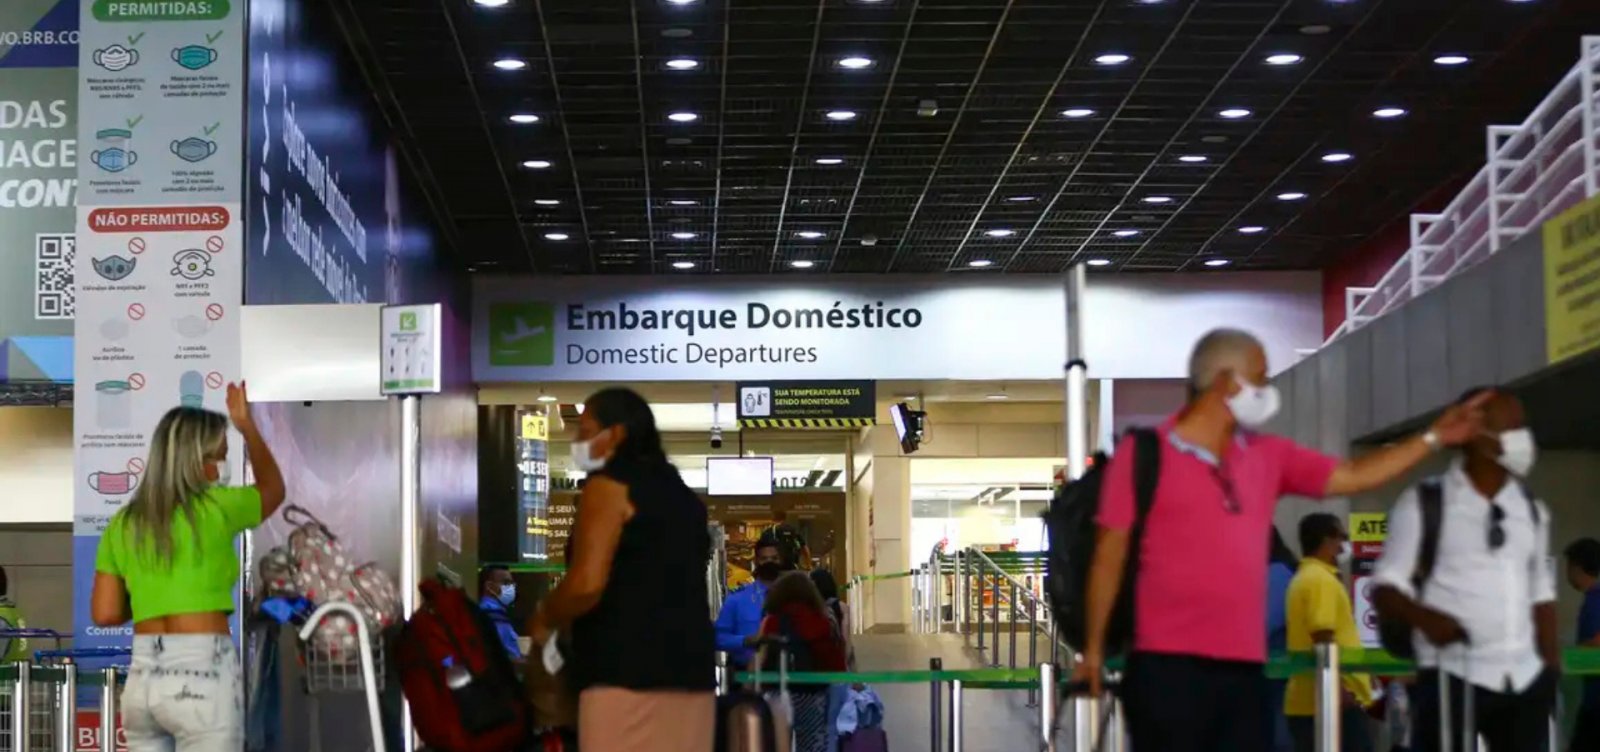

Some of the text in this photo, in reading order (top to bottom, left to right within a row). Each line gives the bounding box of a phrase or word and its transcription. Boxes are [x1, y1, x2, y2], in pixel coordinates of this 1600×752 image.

[108, 1, 212, 16] PERMITIDAS:
[0, 99, 68, 129] DAS
[95, 211, 224, 227] NÃO PERMITIDAS:
[566, 301, 923, 336] Embarque Doméstico
[566, 342, 818, 368] Domestic Departures
[842, 388, 860, 396] ESTÁ
[774, 398, 799, 406] SENDO
